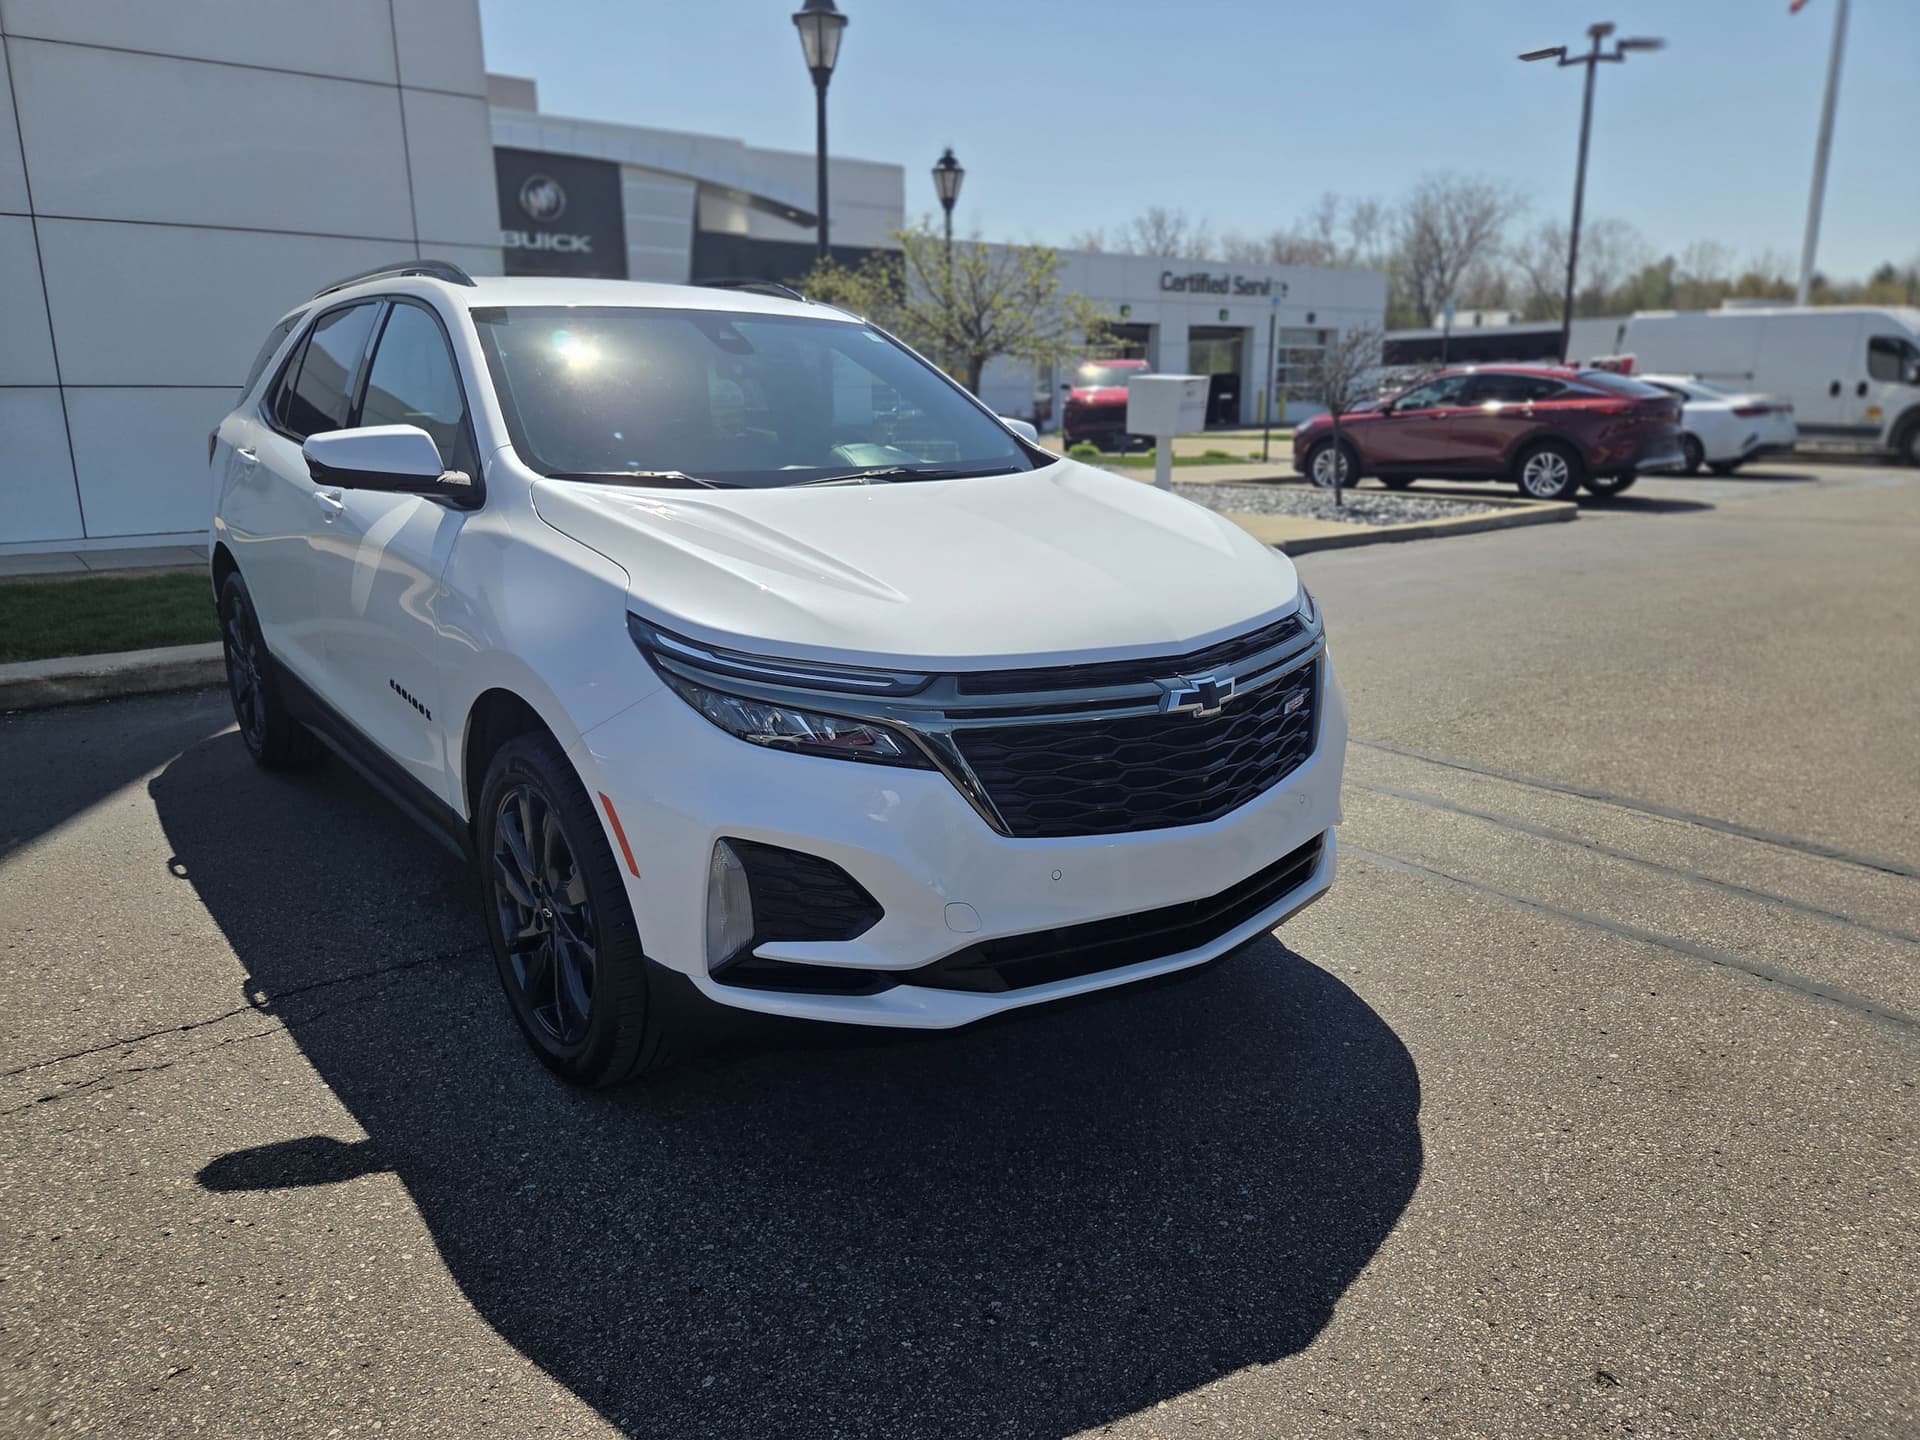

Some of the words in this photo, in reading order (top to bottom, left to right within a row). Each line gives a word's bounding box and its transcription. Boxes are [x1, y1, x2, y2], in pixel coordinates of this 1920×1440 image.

[502, 230, 592, 253] BUICK
[1160, 271, 1230, 294] Certified
[1233, 275, 1288, 298] Servie
